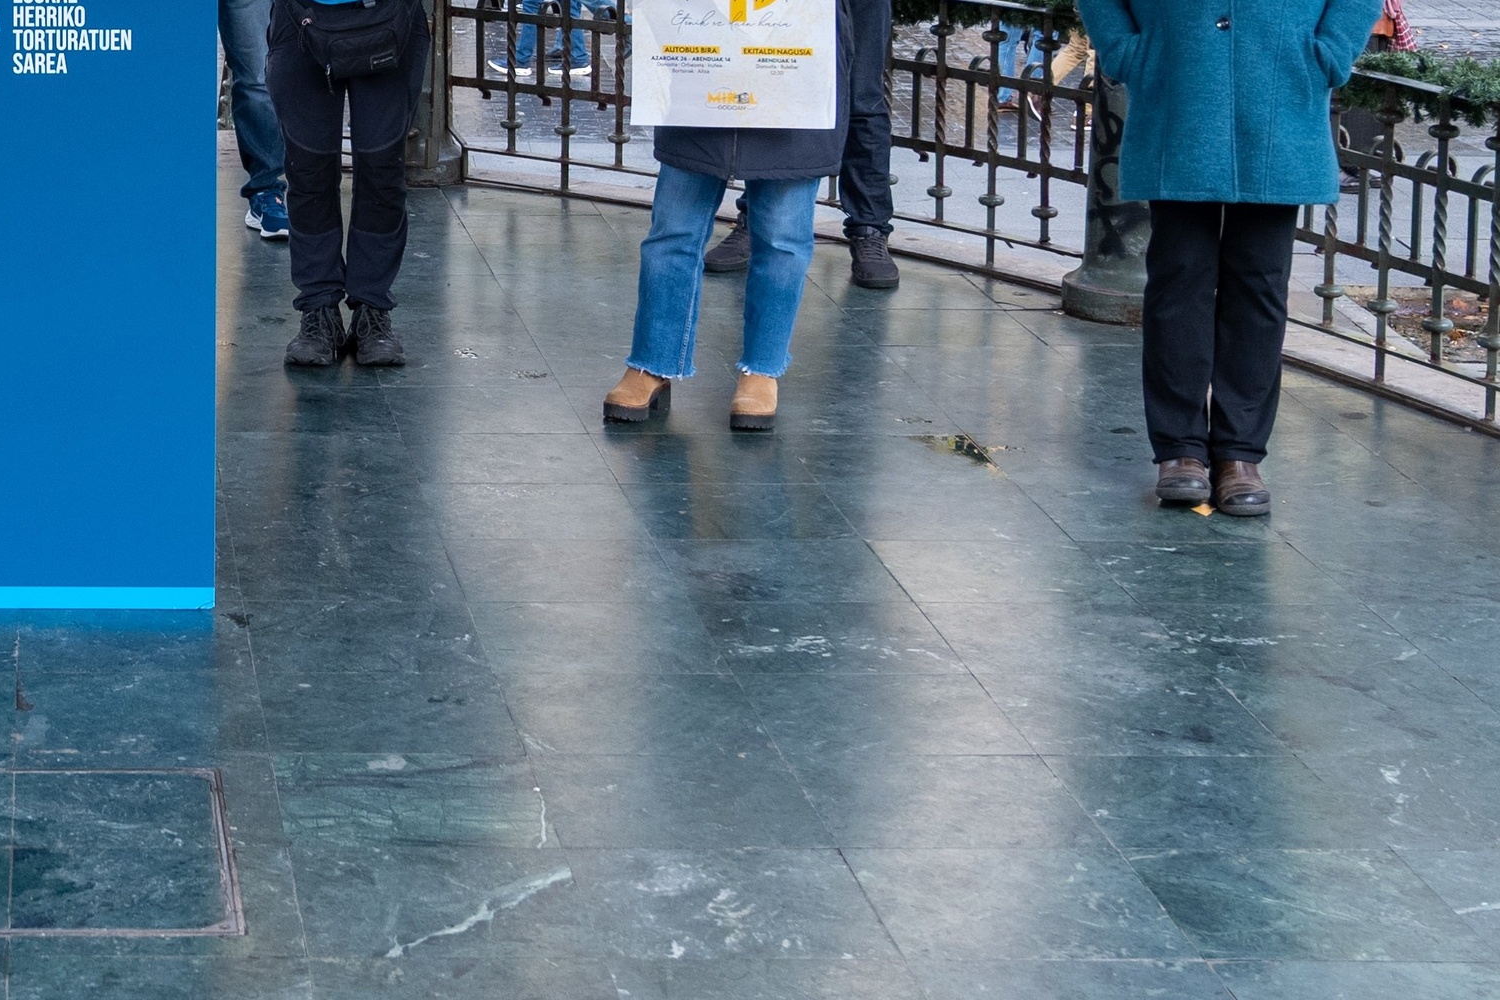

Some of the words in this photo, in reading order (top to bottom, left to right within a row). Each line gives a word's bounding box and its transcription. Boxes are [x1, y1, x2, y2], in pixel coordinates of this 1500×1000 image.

[13, 6, 85, 28] HERRIKO
[13, 29, 132, 51] TORTURATUEN
[13, 52, 67, 74] SAREA
